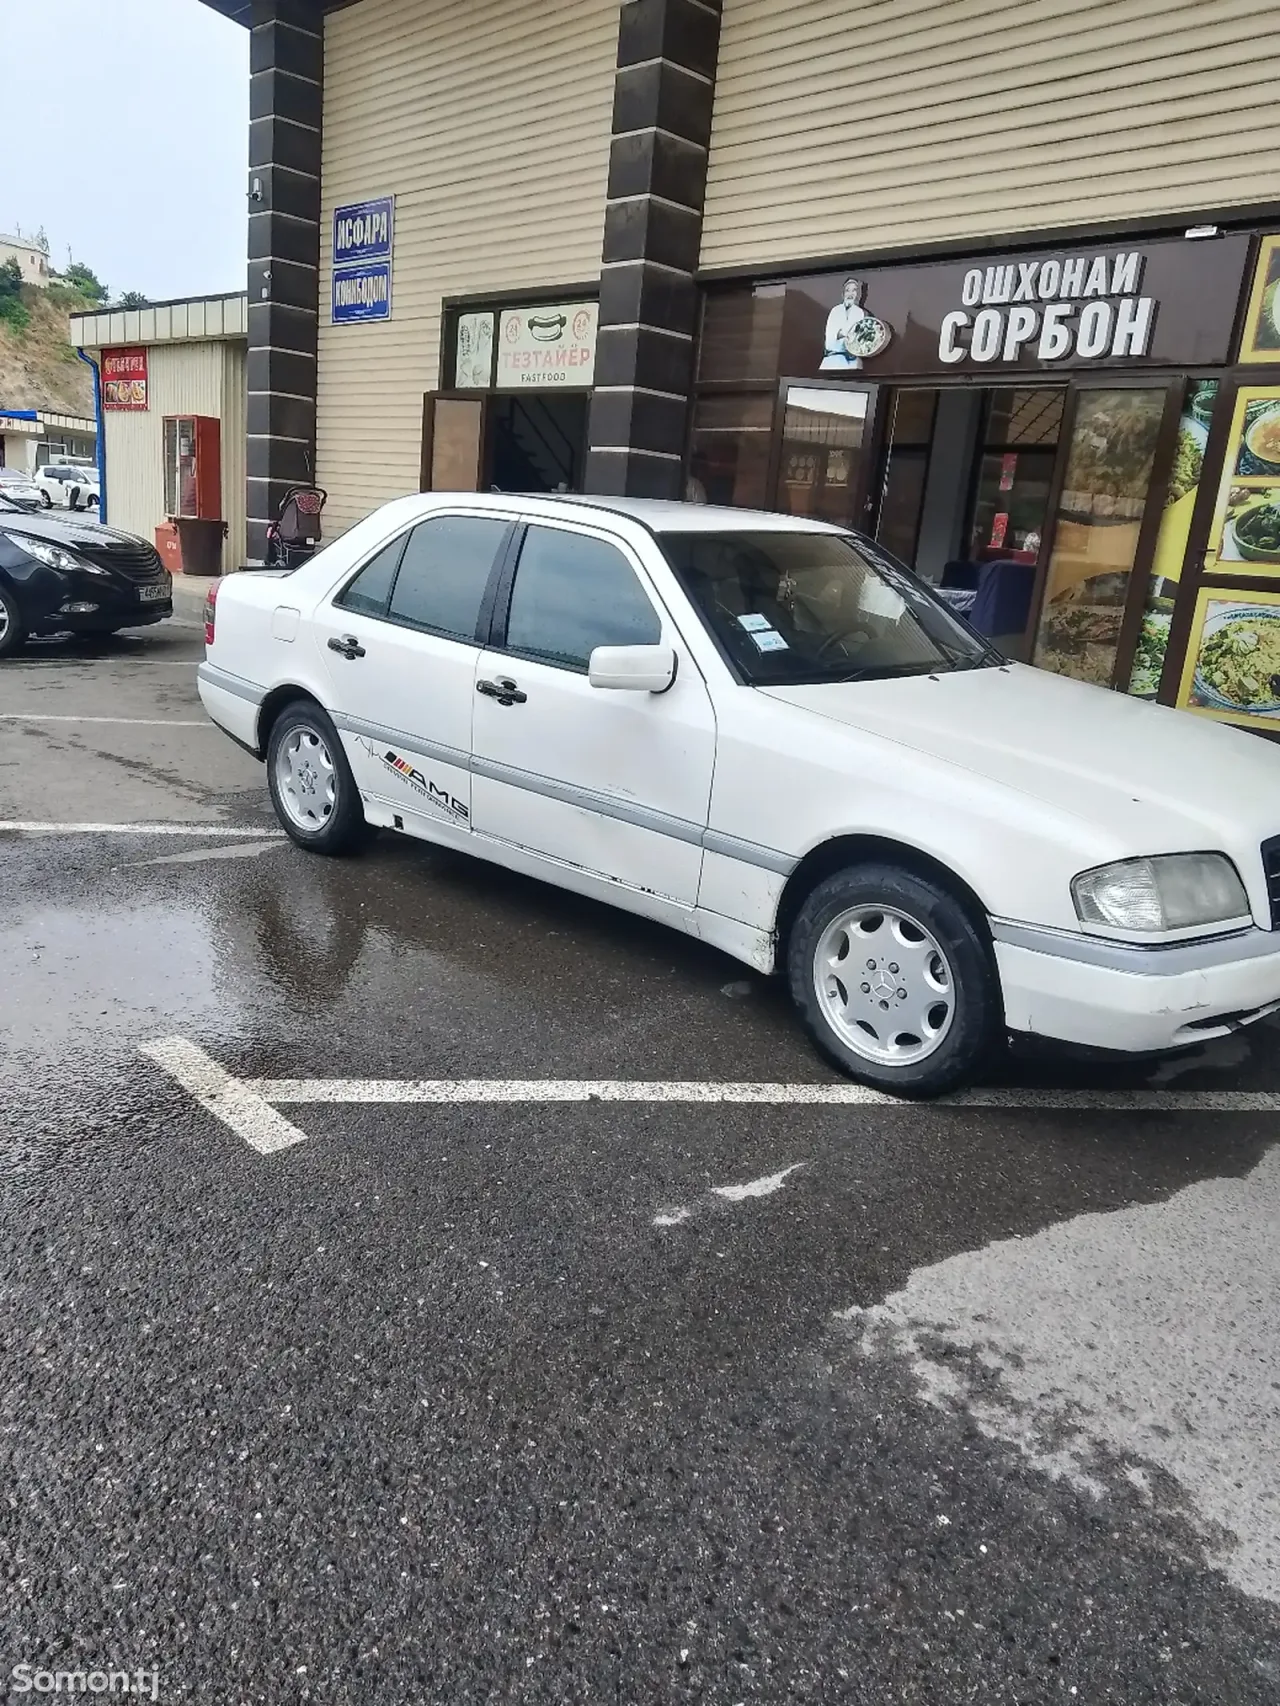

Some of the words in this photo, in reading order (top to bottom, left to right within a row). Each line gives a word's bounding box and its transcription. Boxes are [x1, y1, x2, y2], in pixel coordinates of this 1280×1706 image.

[337, 211, 388, 250] ИСФАРА
[962, 252, 1142, 307] ОШХОНАИ
[938, 297, 1155, 363] СОРБОН
[409, 768, 469, 818] AMG
